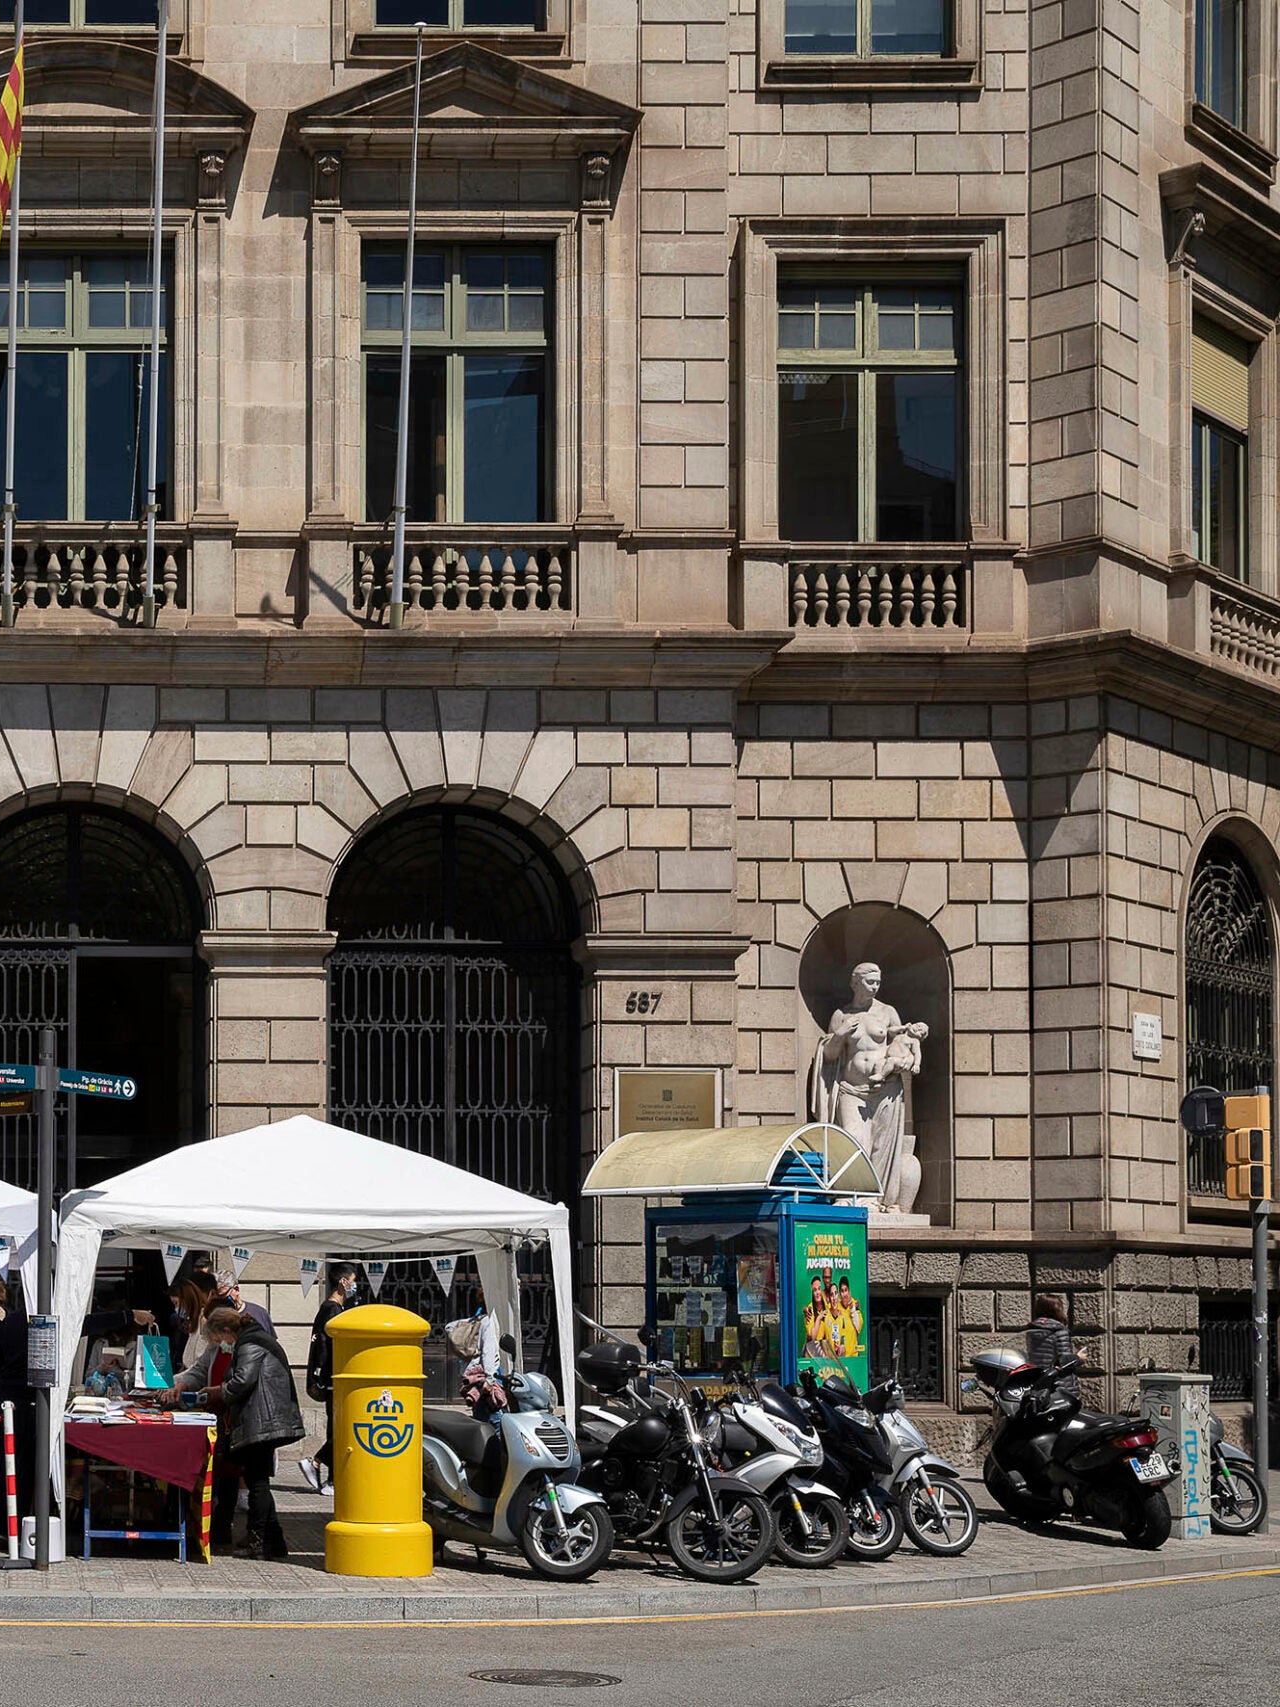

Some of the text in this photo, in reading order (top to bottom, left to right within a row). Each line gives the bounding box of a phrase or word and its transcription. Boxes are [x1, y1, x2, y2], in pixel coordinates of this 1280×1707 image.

[814, 1235, 843, 1245] QUAN TU
[834, 1258, 850, 1270] TOTS
[1142, 1466, 1162, 1478] CRC
